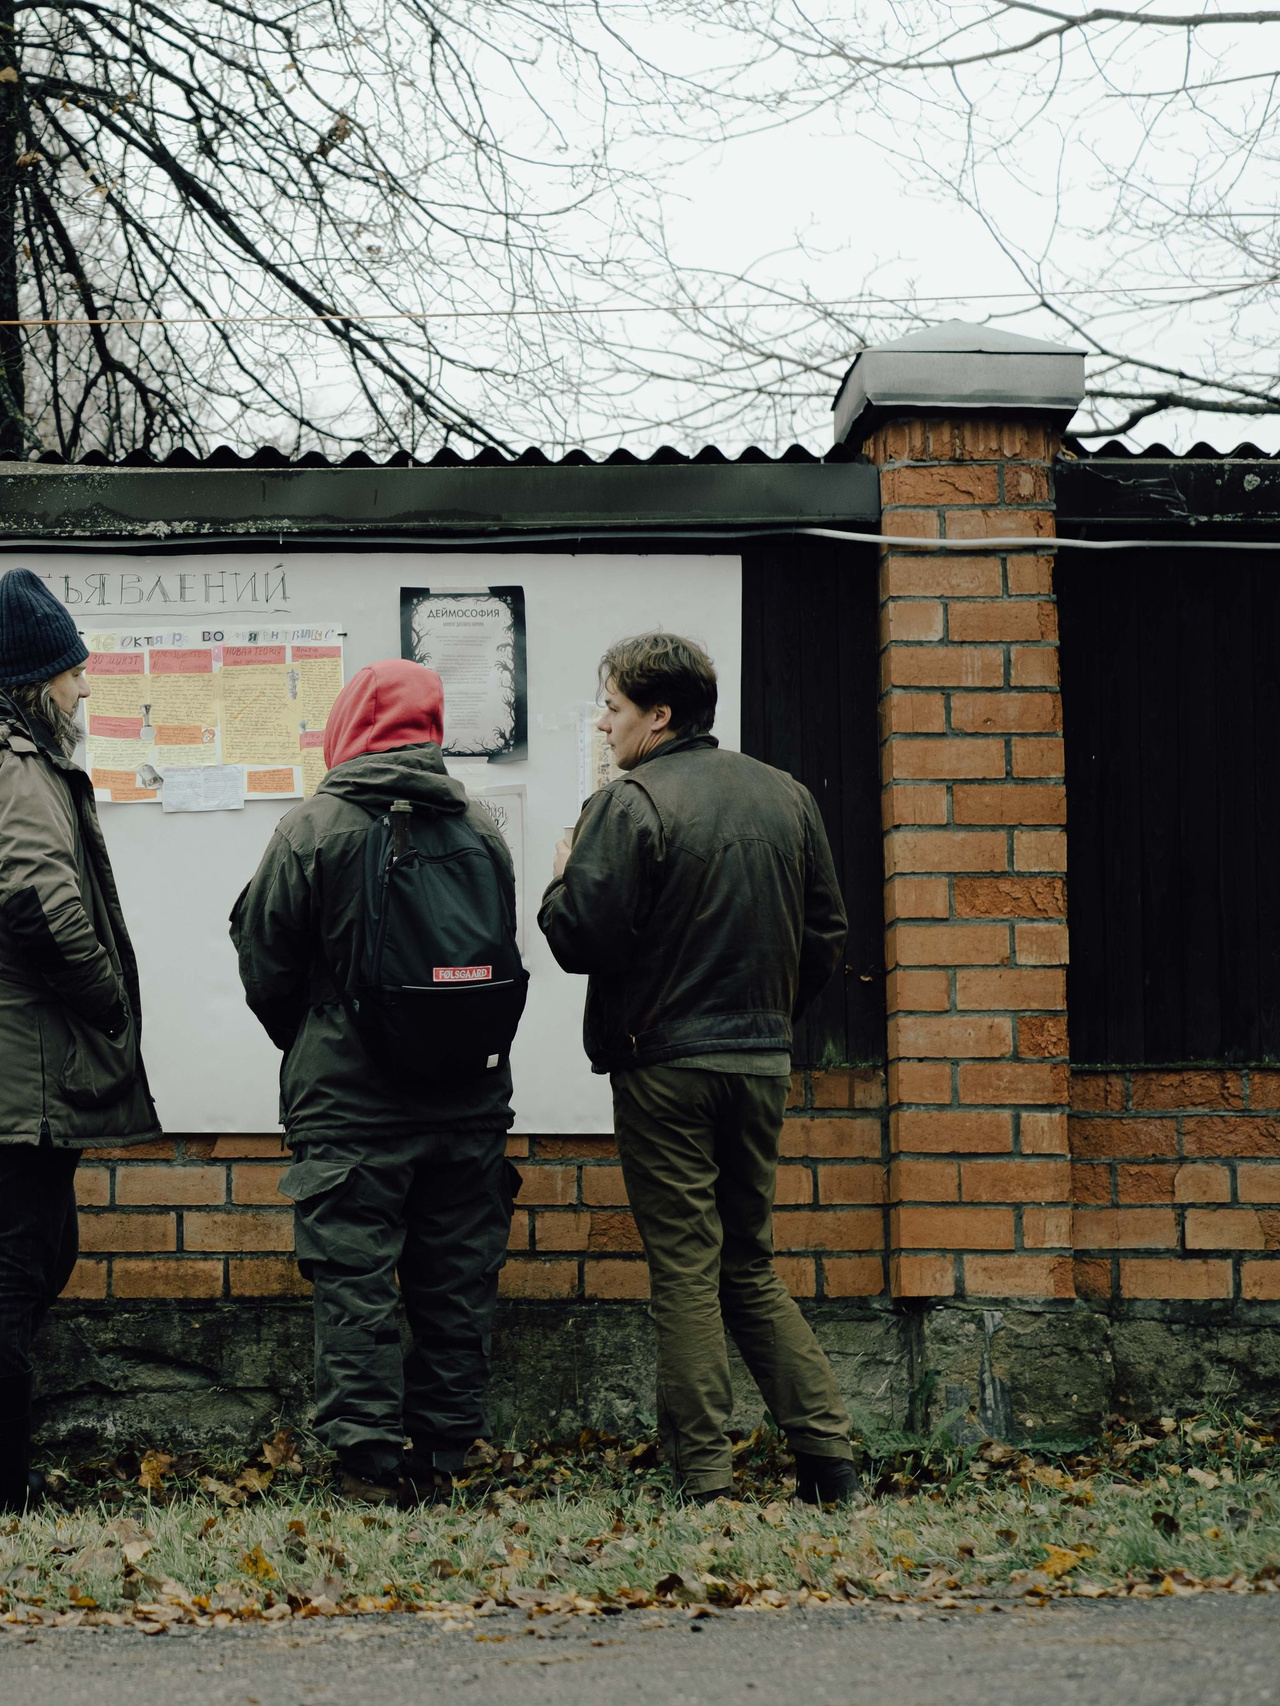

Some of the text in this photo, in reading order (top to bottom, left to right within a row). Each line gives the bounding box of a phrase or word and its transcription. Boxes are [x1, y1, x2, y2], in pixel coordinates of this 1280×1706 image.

[38, 563, 291, 606] ЪЯВЛЕНИЙ
[427, 607, 500, 619] ДЕЙМОСОФИЯ
[439, 969, 487, 979] FØLSGAARD
